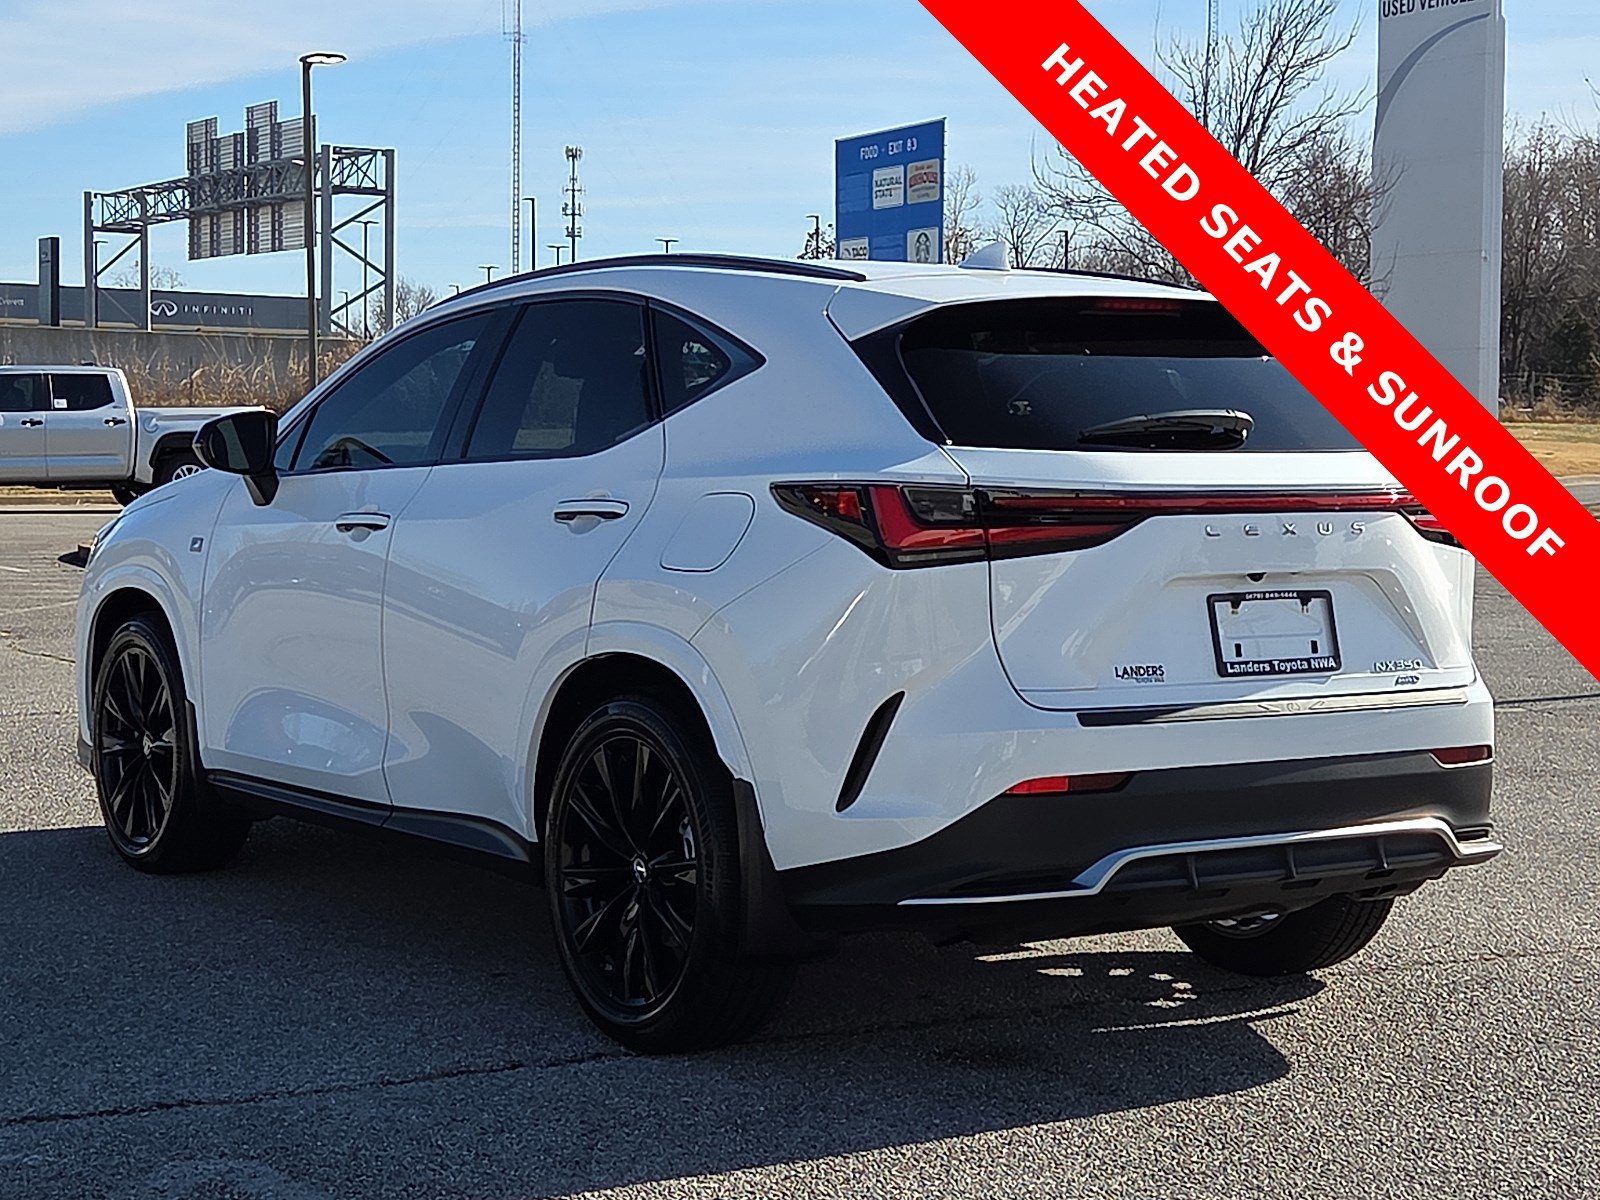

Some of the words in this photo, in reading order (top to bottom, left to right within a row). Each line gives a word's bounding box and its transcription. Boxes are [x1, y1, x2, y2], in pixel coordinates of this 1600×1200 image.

[1382, 0, 1415, 18] USED
[860, 145, 879, 160] FOOD
[888, 140, 903, 155] EXIT
[874, 175, 903, 188] NATURAL
[874, 187, 893, 199] STATE
[184, 304, 252, 316] INFINITI
[1204, 521, 1366, 537] LEXUS
[1114, 665, 1165, 679] LANDERS
[1227, 661, 1270, 673] Landers
[1272, 659, 1308, 673] Toyota
[1311, 657, 1337, 669] NWA
